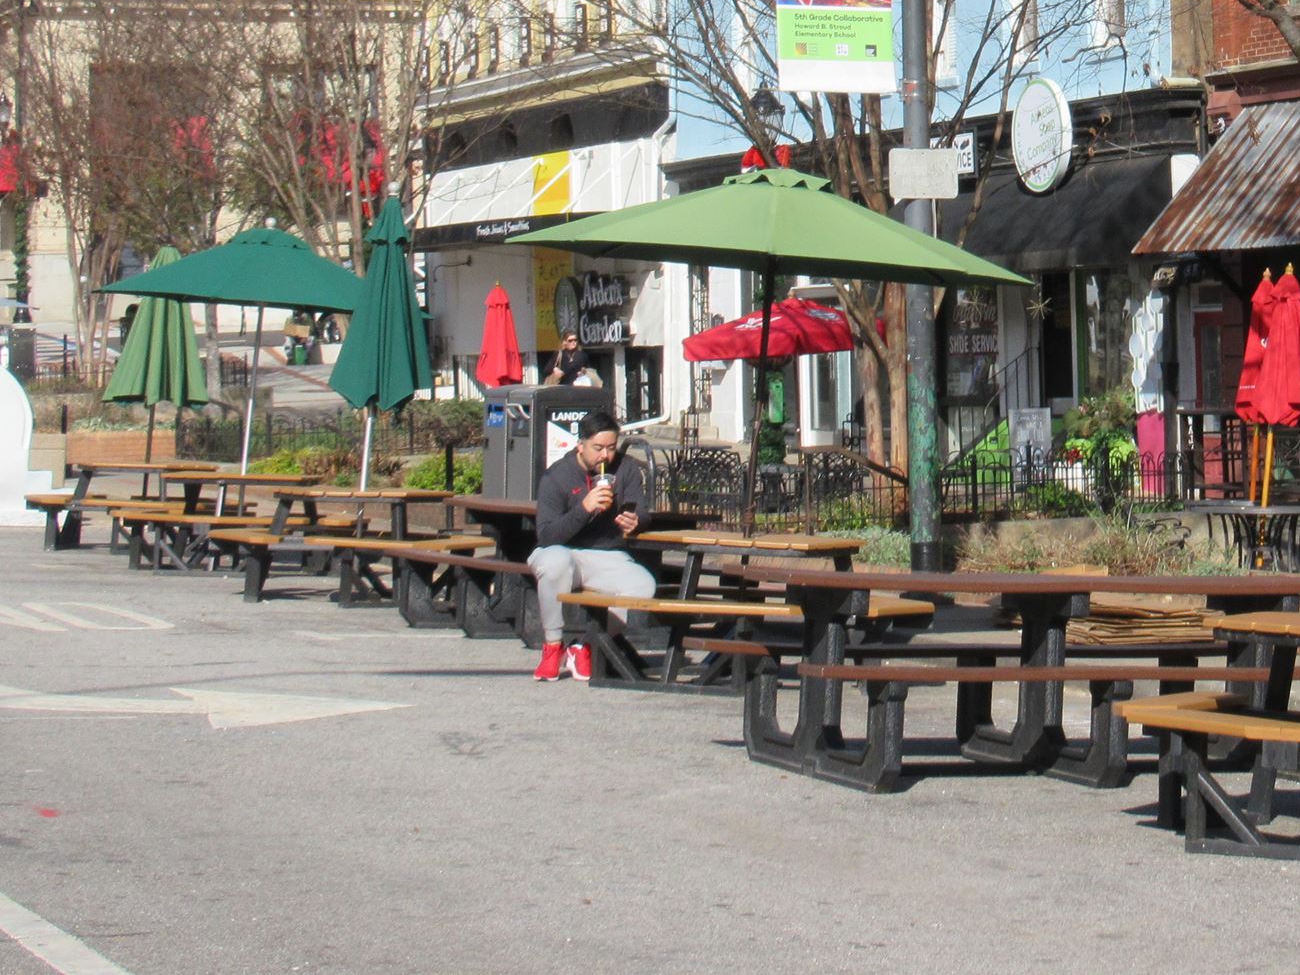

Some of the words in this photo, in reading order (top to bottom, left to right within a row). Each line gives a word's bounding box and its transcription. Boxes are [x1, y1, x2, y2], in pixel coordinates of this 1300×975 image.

[794, 13, 807, 21] 5th
[809, 14, 832, 22] Grade
[833, 14, 884, 23] Collaborative
[829, 23, 851, 31] Stroud
[794, 31, 832, 39] Elementary
[834, 31, 856, 39] School
[580, 273, 623, 310] Arden's
[580, 312, 623, 345] Garden
[949, 334, 969, 354] SHOE
